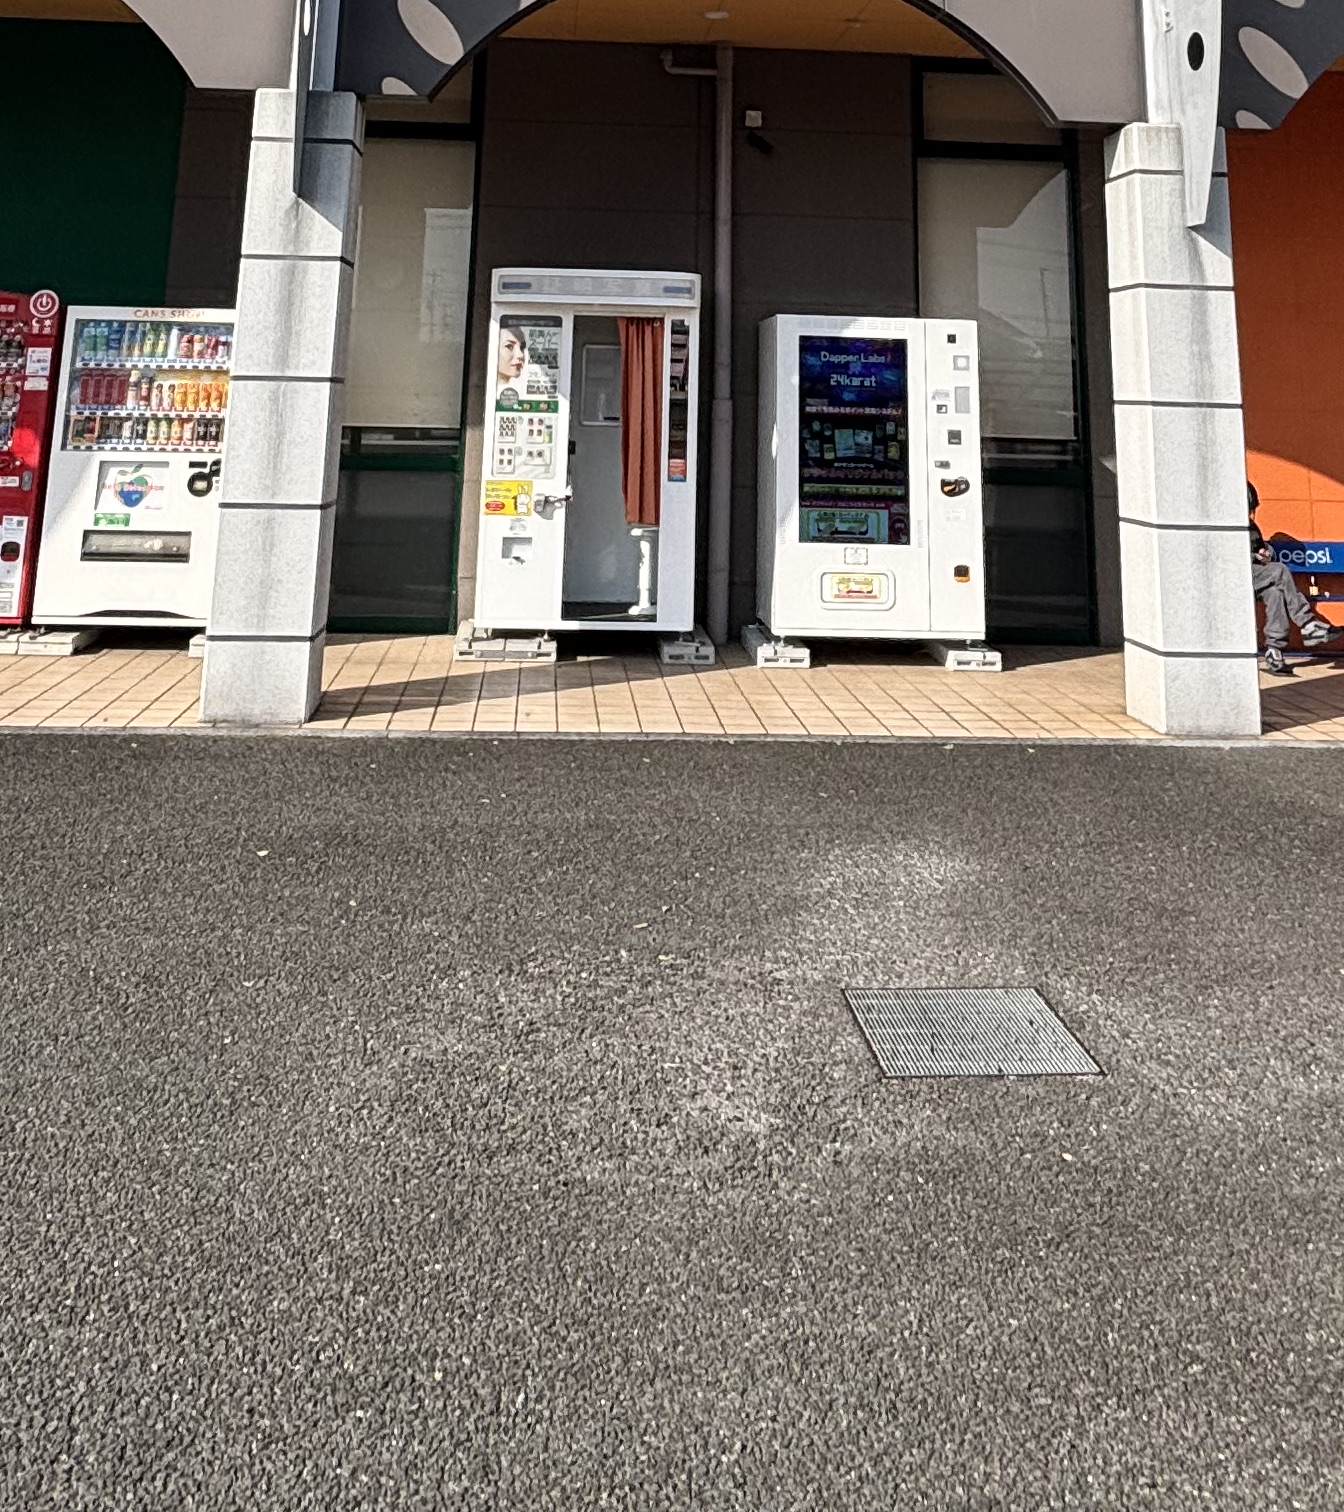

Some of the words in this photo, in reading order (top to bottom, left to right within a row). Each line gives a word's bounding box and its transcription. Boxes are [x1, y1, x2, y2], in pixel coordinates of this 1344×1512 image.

[134, 309, 166, 318] CANS
[820, 351, 859, 364] Dapper
[861, 352, 886, 364] Labs
[830, 373, 877, 387] 24karat
